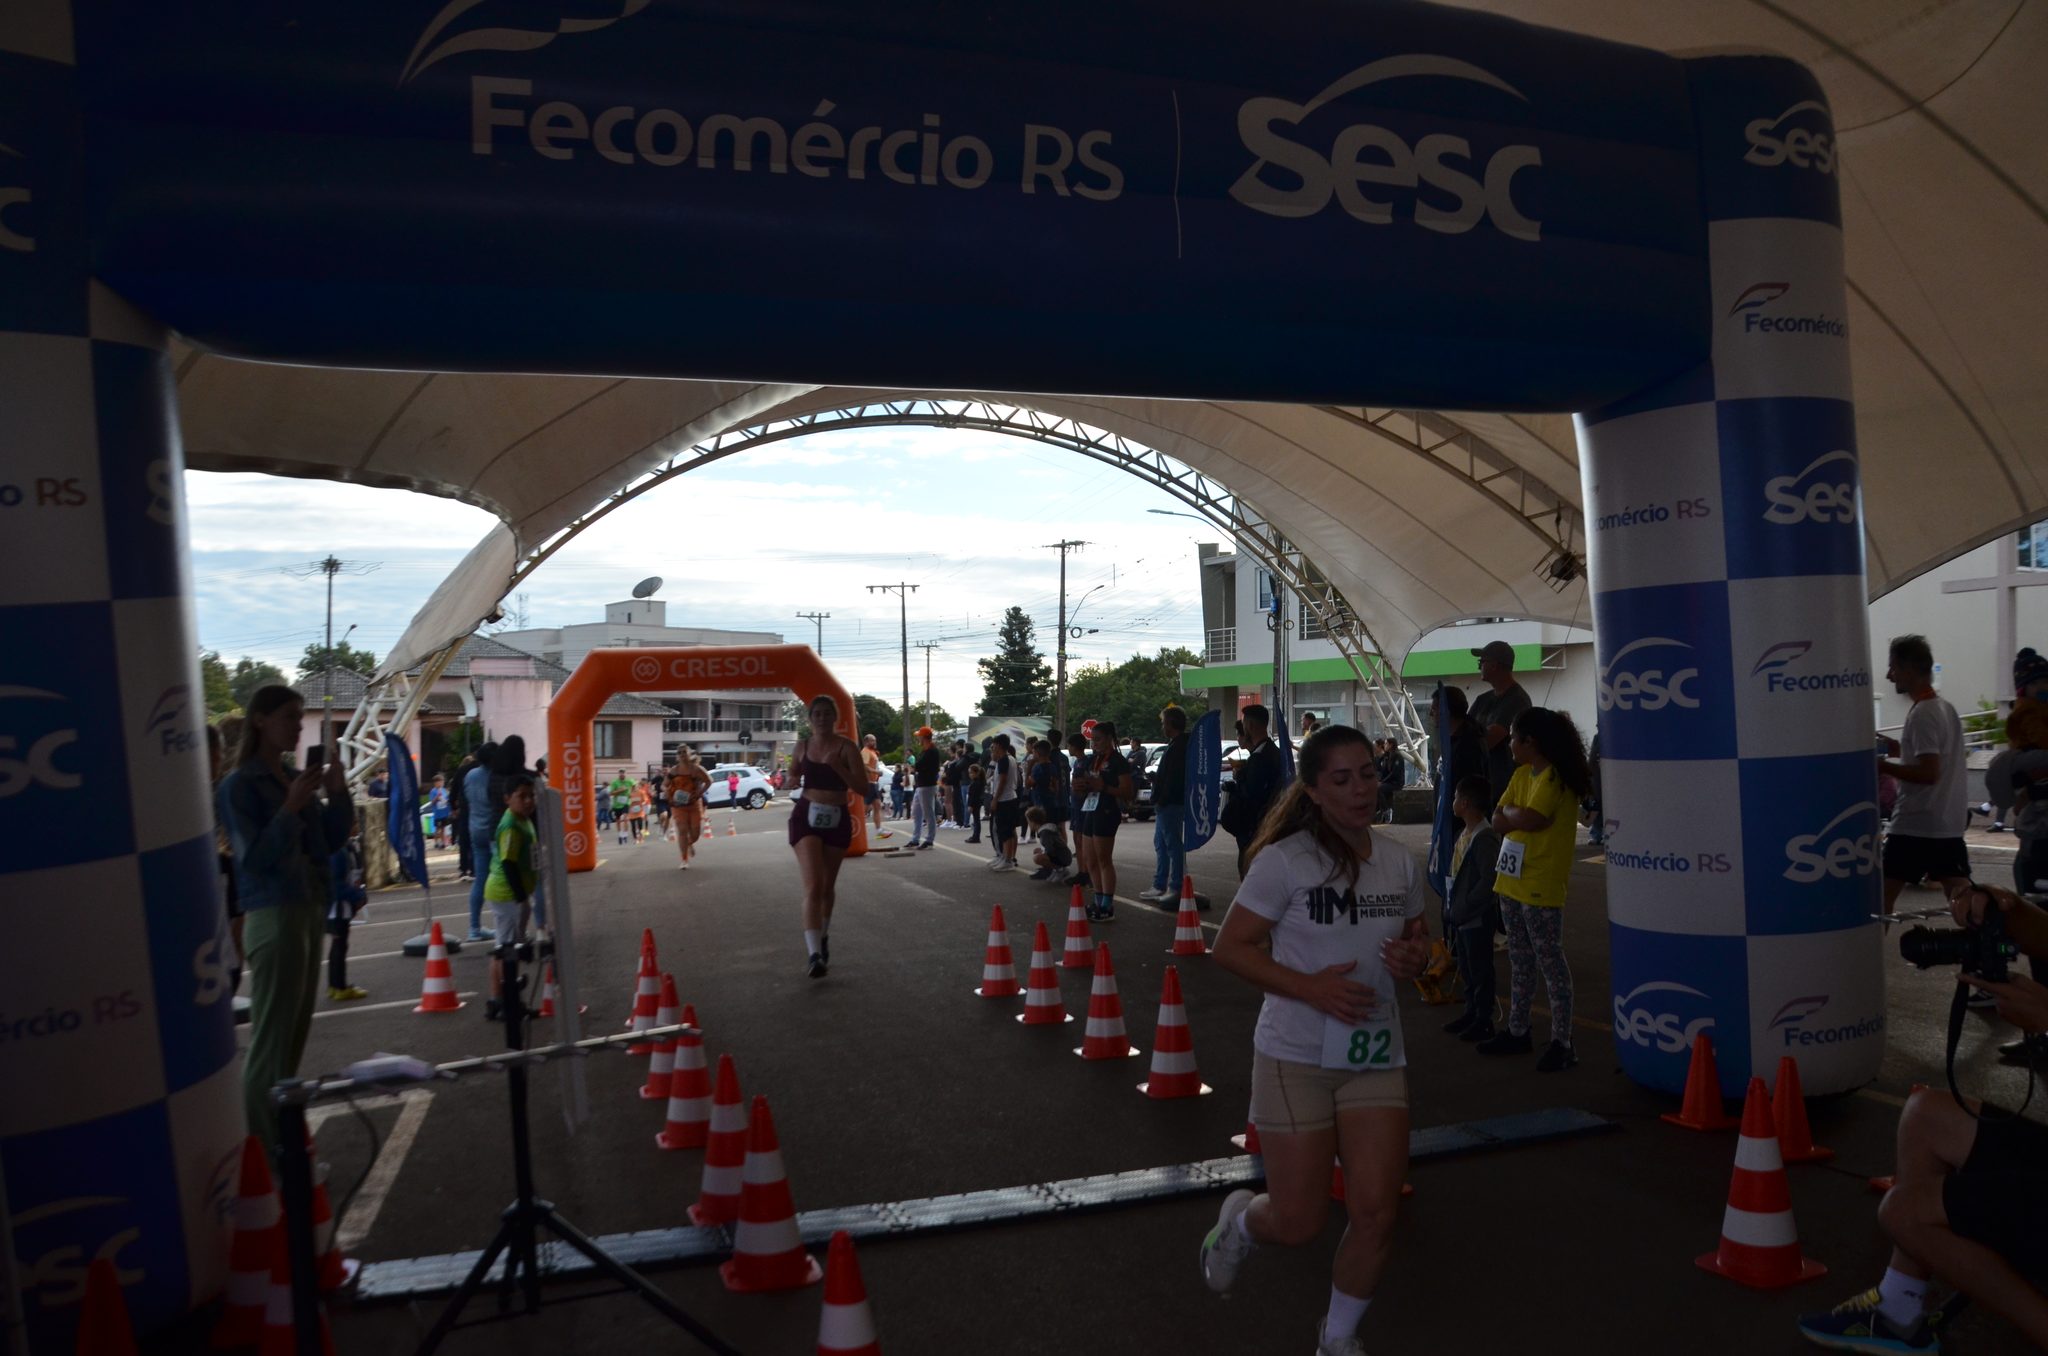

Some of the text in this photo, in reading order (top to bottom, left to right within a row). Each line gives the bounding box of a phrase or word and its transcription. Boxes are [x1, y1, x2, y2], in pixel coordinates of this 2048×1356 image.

[471, 75, 1125, 201] Fecomércio RS
[1744, 110, 1842, 174] Ses
[1228, 80, 1543, 242] Sesc
[36, 478, 87, 506] RS
[1762, 470, 1858, 525] Ses
[1596, 497, 1711, 531] omércio RS
[670, 656, 776, 679] CRESOL
[562, 735, 584, 826] CRESOL
[815, 813, 832, 826] 53
[1195, 783, 1211, 838] Sesc
[1497, 852, 1517, 874] 93
[1697, 853, 1732, 873] RS
[93, 990, 143, 1024] RS
[1614, 990, 1717, 1056] Sesc
[1347, 1029, 1391, 1065] 82
